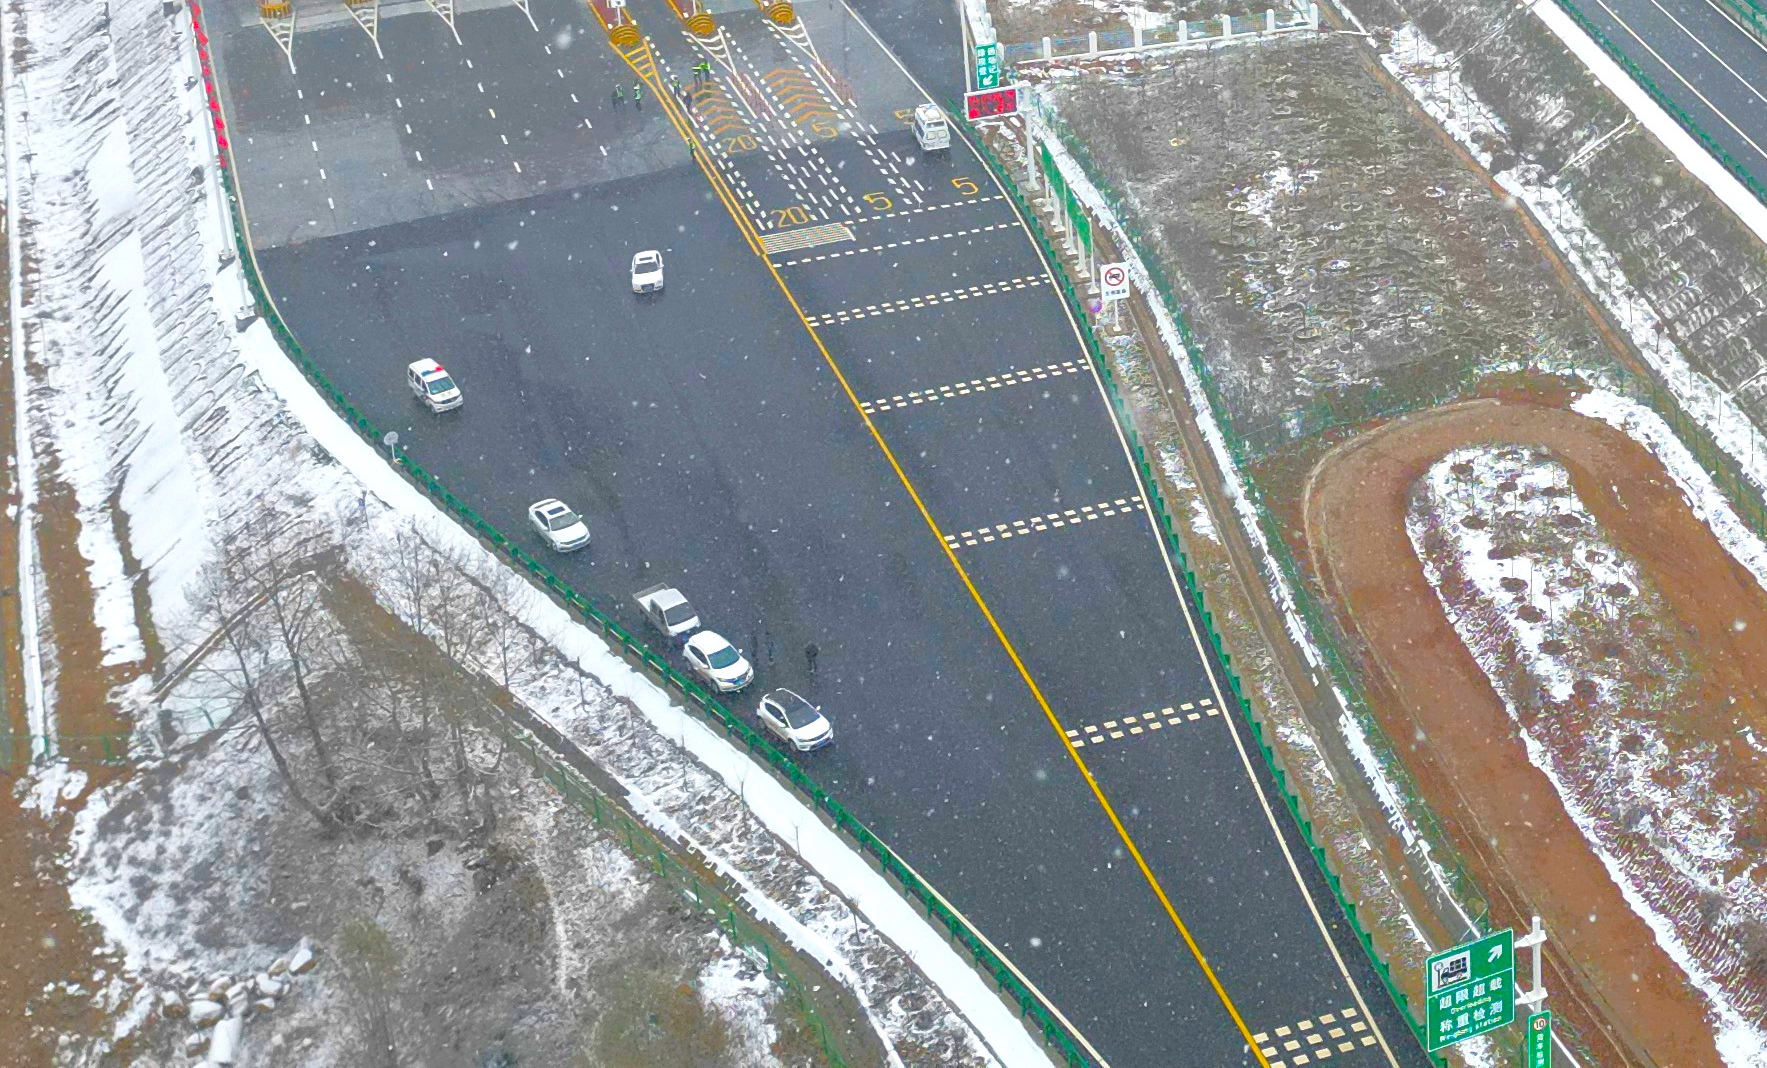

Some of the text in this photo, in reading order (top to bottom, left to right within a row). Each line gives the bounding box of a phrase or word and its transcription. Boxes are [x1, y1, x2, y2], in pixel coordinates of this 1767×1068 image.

[811, 122, 838, 139] 5
[722, 134, 758, 154] 20
[951, 177, 979, 195] 5
[862, 191, 893, 211] 5
[771, 206, 810, 228] 20
[1439, 1000, 1503, 1033] 称重检测
[1536, 1019, 1545, 1028] 10
